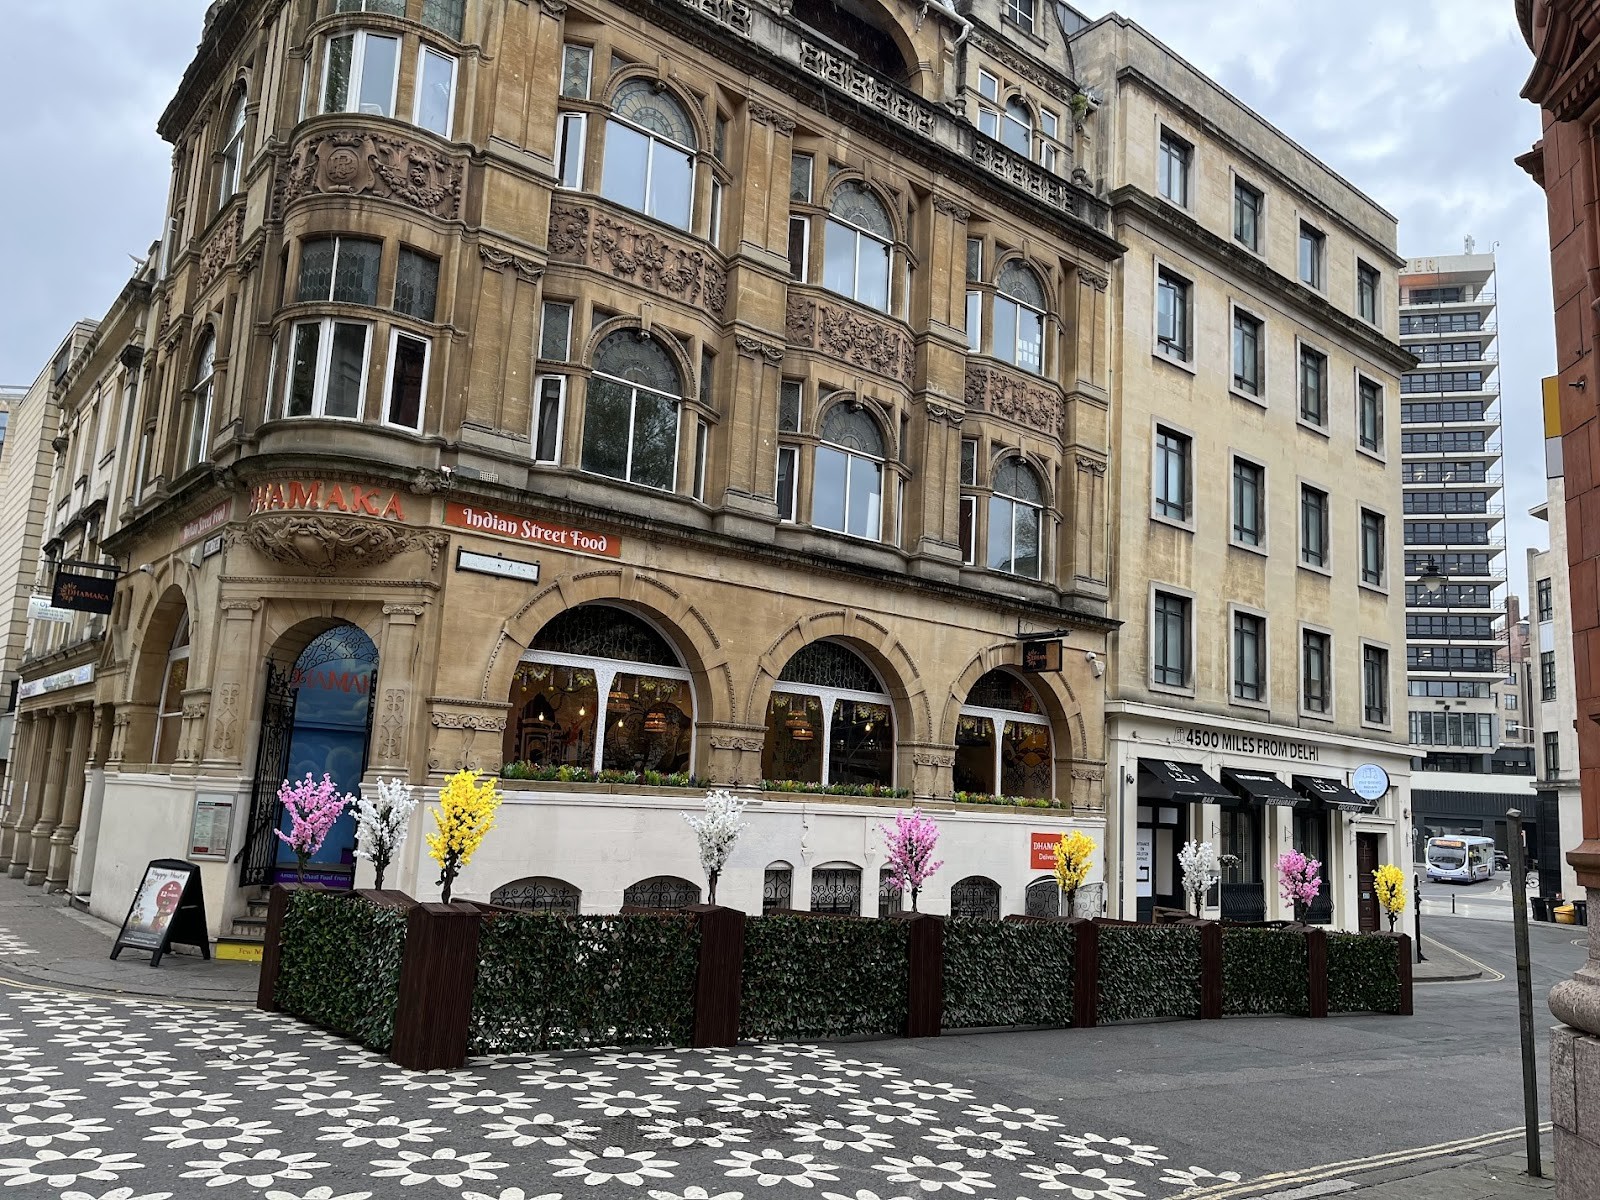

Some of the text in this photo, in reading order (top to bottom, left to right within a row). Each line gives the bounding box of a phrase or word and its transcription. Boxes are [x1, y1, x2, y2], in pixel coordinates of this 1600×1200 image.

[250, 480, 405, 521] HAMAKA
[462, 508, 608, 552] Indian Street Food
[67, 588, 110, 601] DHAMAKA
[1186, 728, 1319, 762] 4500 MILES FROM DELHI
[1201, 796, 1215, 804] BAR
[1265, 798, 1299, 807] RESTAURANT
[1337, 804, 1362, 812] COCKTAILS
